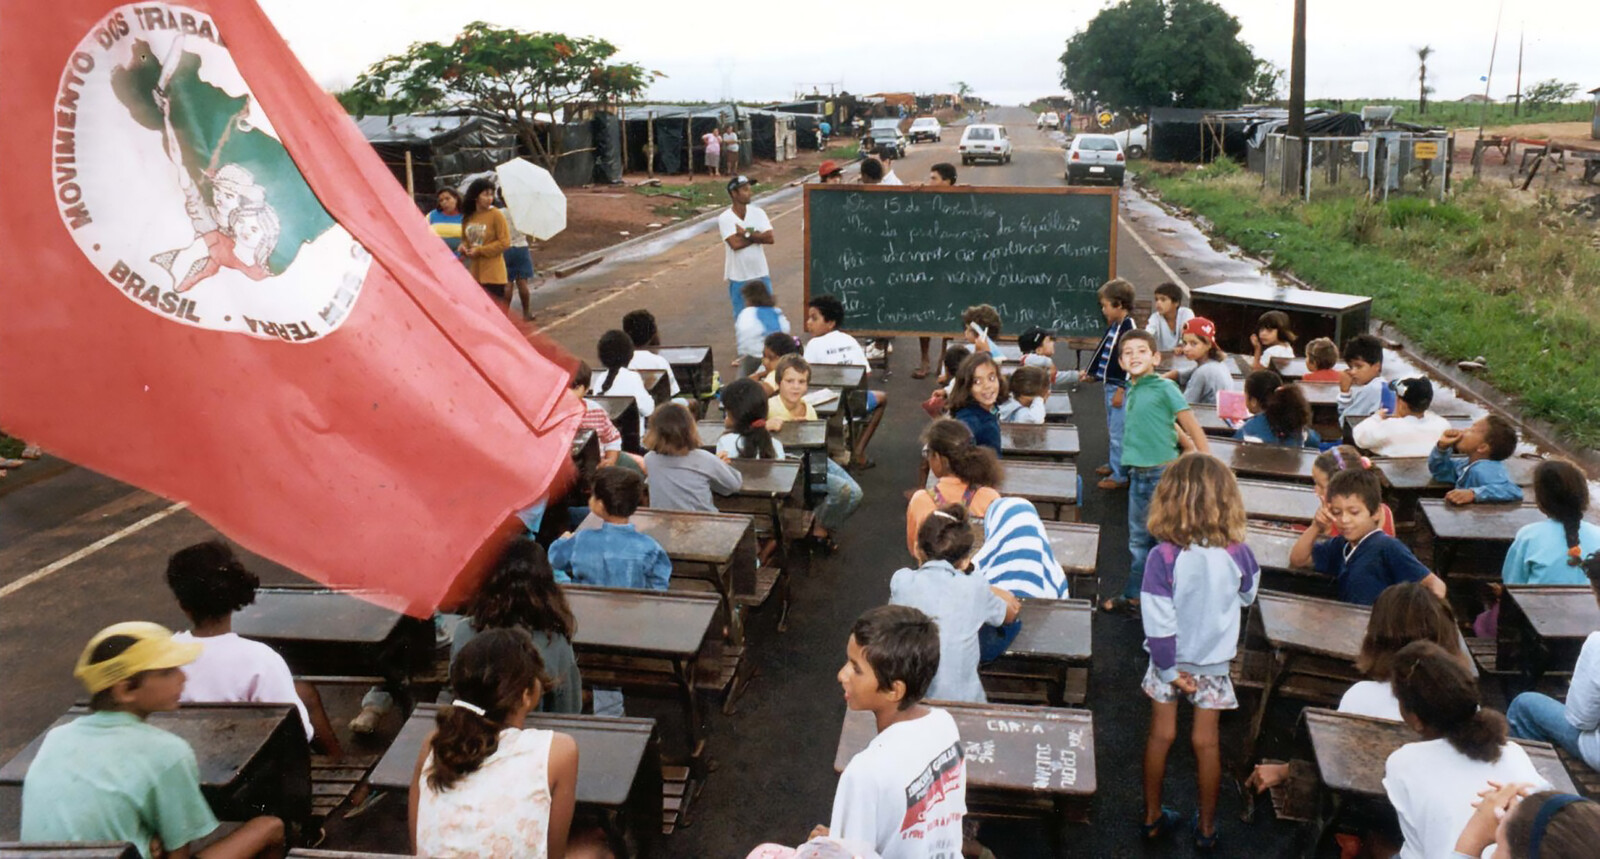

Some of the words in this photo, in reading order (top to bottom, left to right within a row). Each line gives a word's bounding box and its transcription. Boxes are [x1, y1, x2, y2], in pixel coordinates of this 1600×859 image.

[54, 51, 95, 230] MOVIMENTO
[95, 11, 130, 51] DOS
[883, 196, 901, 215] 15
[108, 260, 201, 323] BRASIL
[242, 313, 319, 341] TERRA
